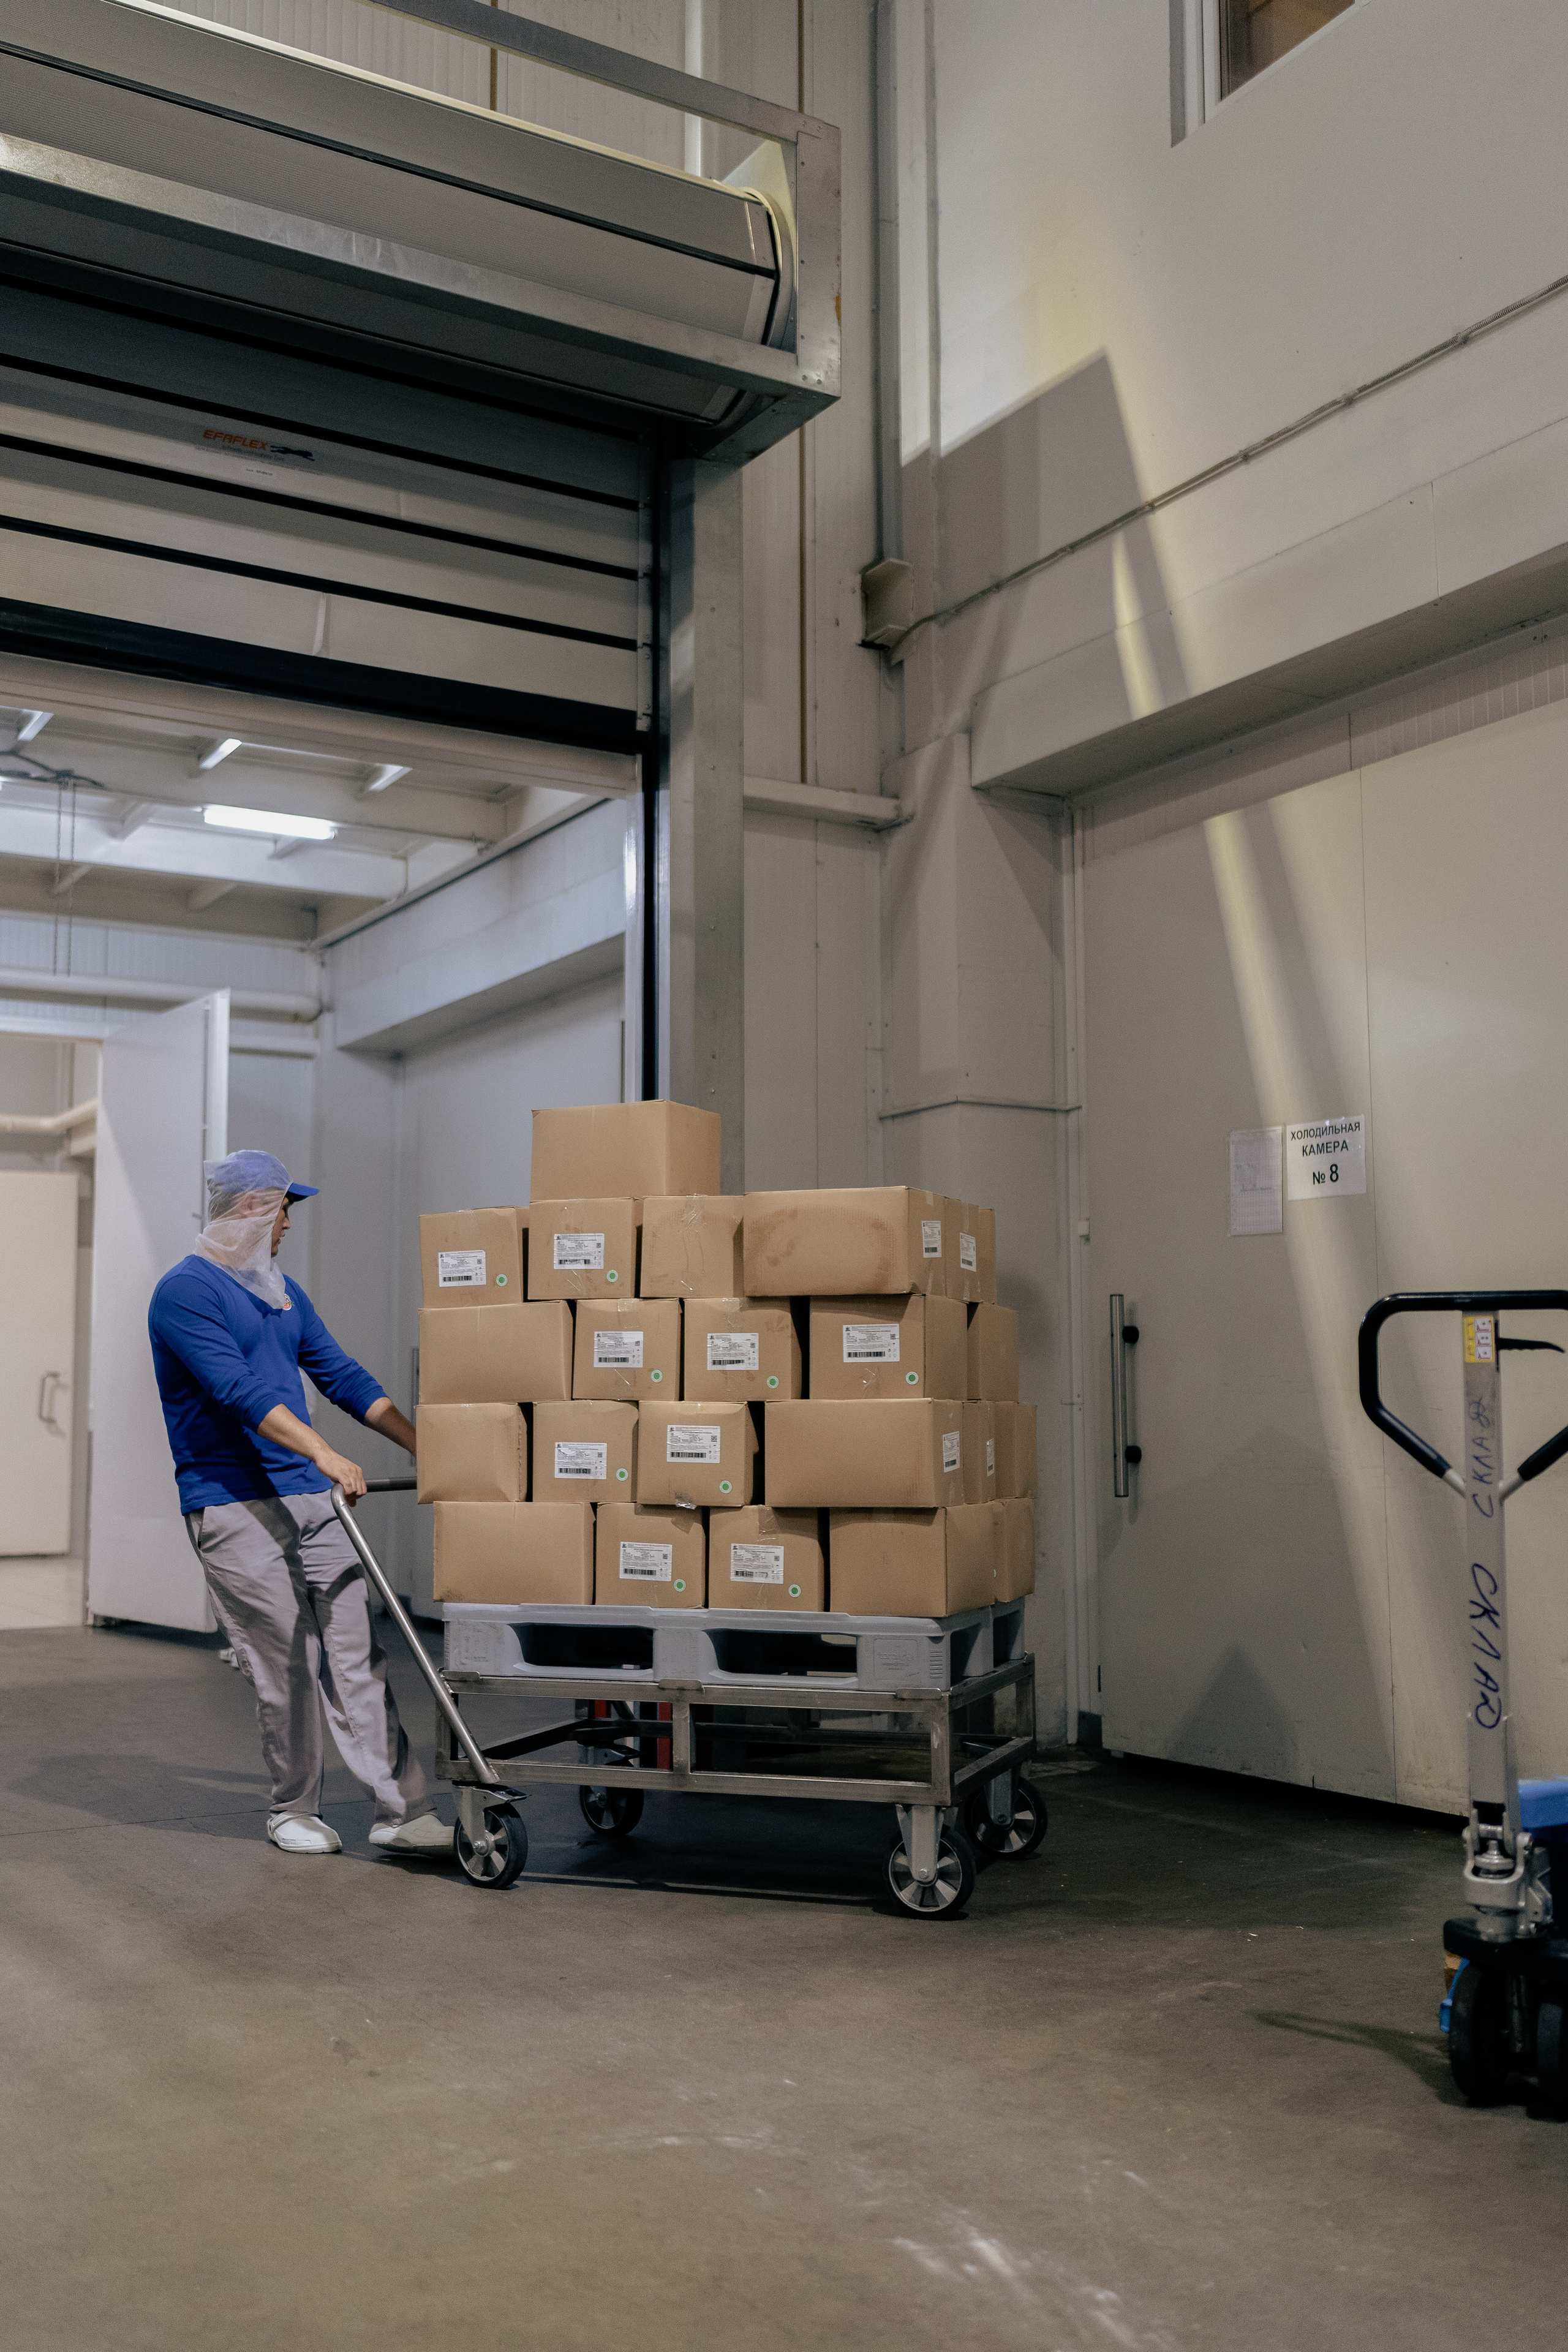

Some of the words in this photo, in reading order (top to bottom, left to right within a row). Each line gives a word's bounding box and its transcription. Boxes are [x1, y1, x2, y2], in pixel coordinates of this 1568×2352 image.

[203, 429, 268, 451] EFAFLEX
[1291, 1121, 1361, 1141] ХОЛОДИЛЬНАЯ
[1302, 1139, 1349, 1157] КАМЕРА
[1312, 1170, 1326, 1185] №
[1329, 1163, 1340, 1183] 8
